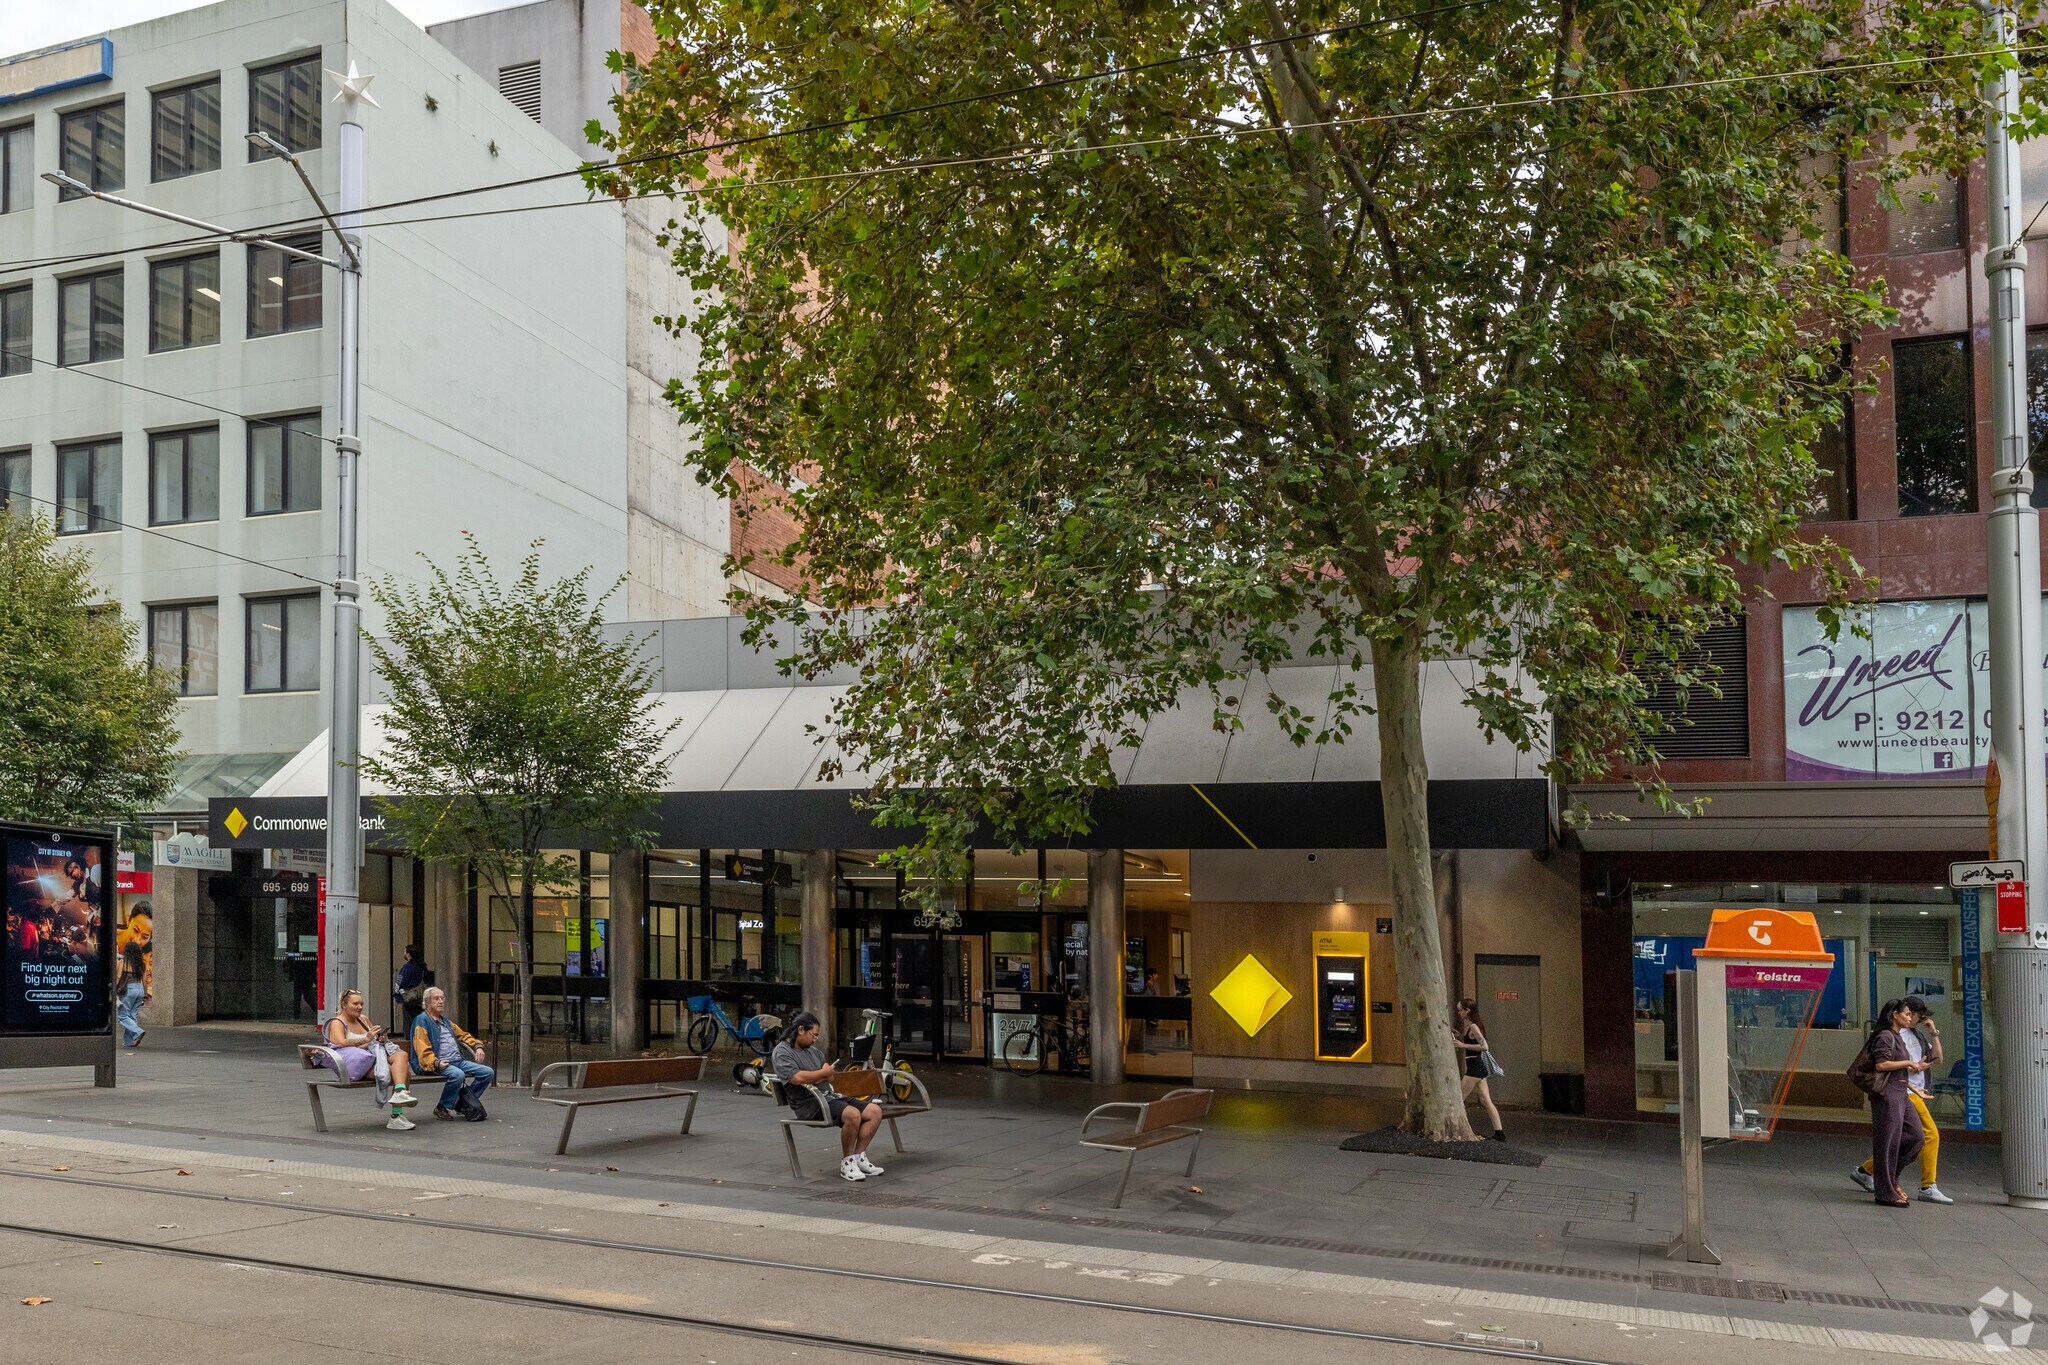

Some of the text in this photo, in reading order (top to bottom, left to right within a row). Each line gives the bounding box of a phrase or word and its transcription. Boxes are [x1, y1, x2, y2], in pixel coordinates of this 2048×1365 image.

[1797, 613, 1963, 727] Uneed
[1854, 712, 1884, 732] P:
[1897, 709, 1964, 731] 9212
[181, 846, 226, 860] MAGILL
[262, 882, 281, 892] 695
[291, 882, 309, 892] 699
[21, 962, 88, 977] Find your next
[1964, 960, 1979, 970] &
[25, 974, 84, 987] big night out
[1756, 971, 1802, 982] Telstra
[1966, 973, 1981, 1049] EXCHANGE
[999, 1019, 1032, 1031] 24/7
[1968, 1053, 1983, 1126] CURRENCY
